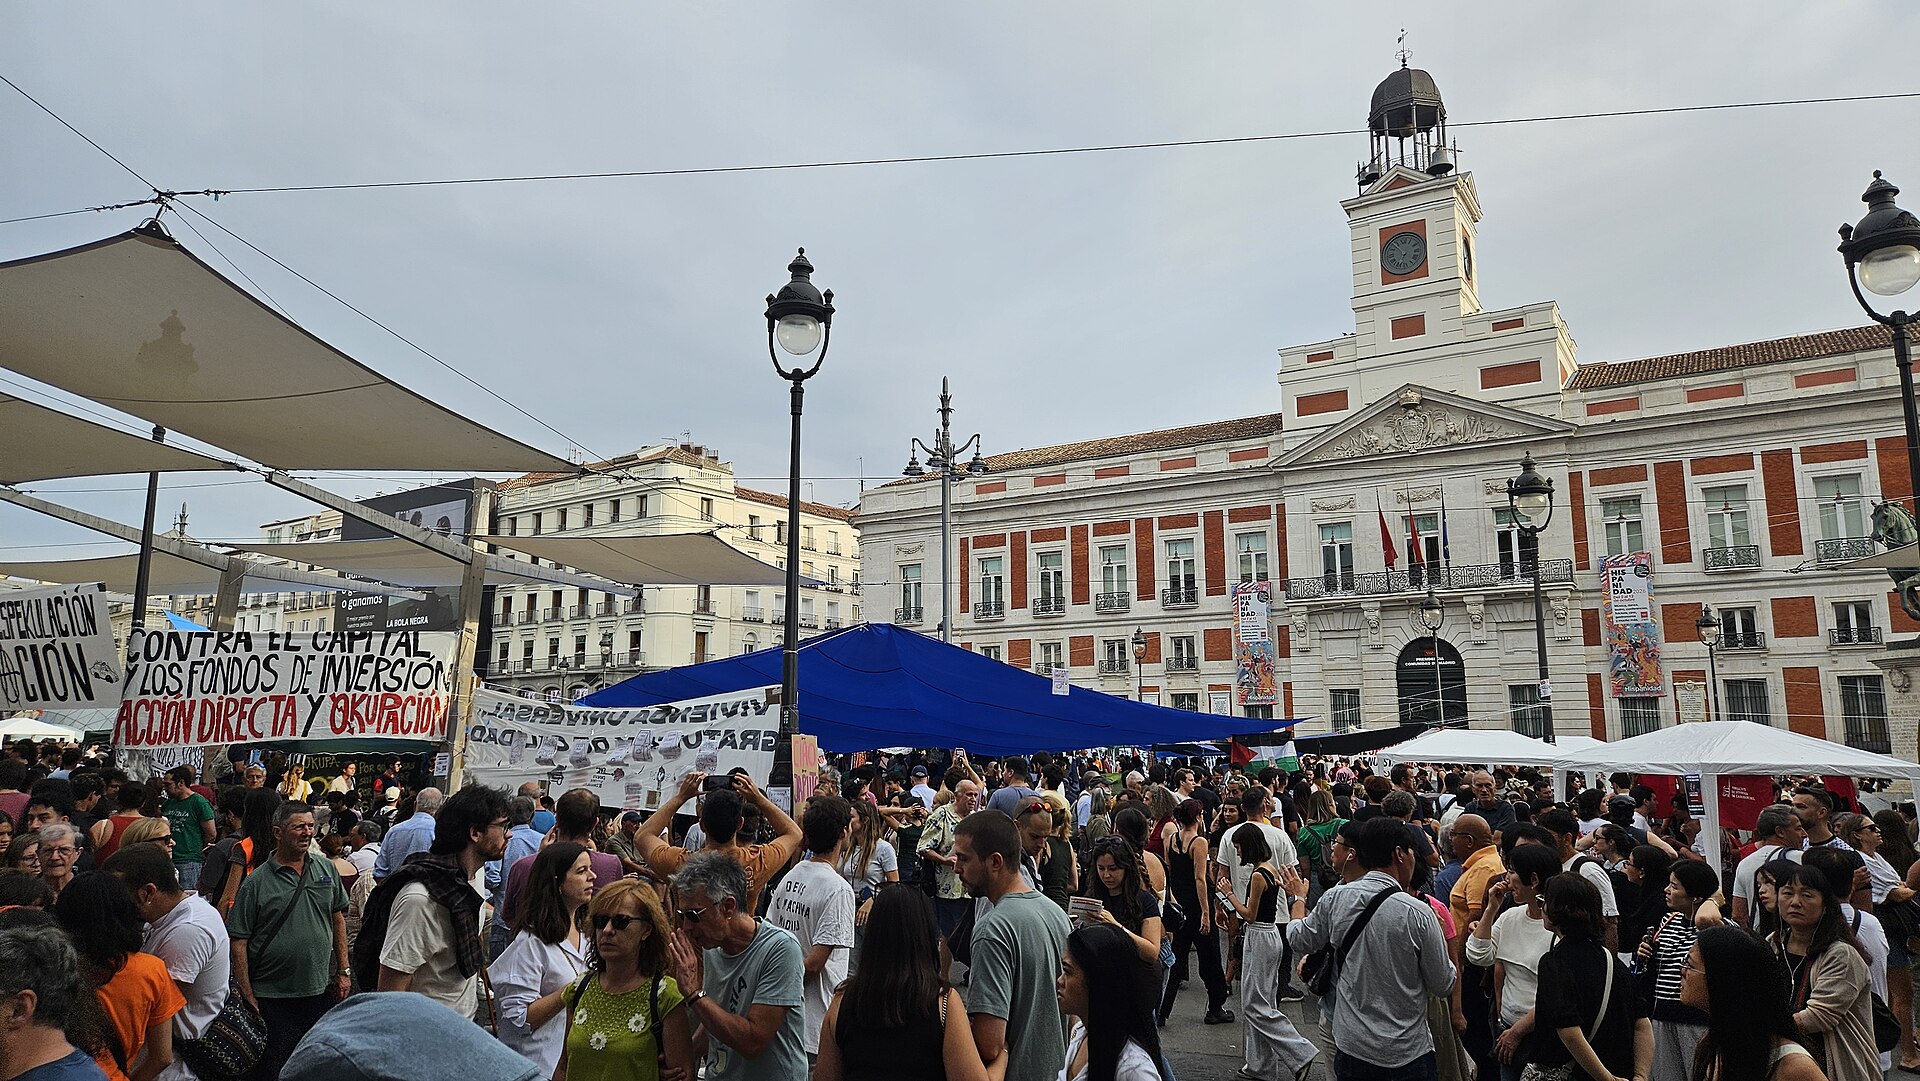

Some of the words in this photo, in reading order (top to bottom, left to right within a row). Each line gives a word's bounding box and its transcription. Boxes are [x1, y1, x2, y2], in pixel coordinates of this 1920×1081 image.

[0, 585, 98, 639] SPEKULACIÓN
[348, 595, 383, 610] ganamos
[386, 619, 394, 628] LA
[394, 618, 409, 627] BOLA
[409, 616, 429, 625] NEGRA
[127, 628, 253, 663] CONTRA
[268, 631, 301, 652] EL
[138, 662, 184, 697] LOS
[186, 653, 280, 698] FONDOS
[289, 654, 316, 695] DE
[318, 654, 453, 693] INVERSIÓN
[301, 694, 325, 738] Y
